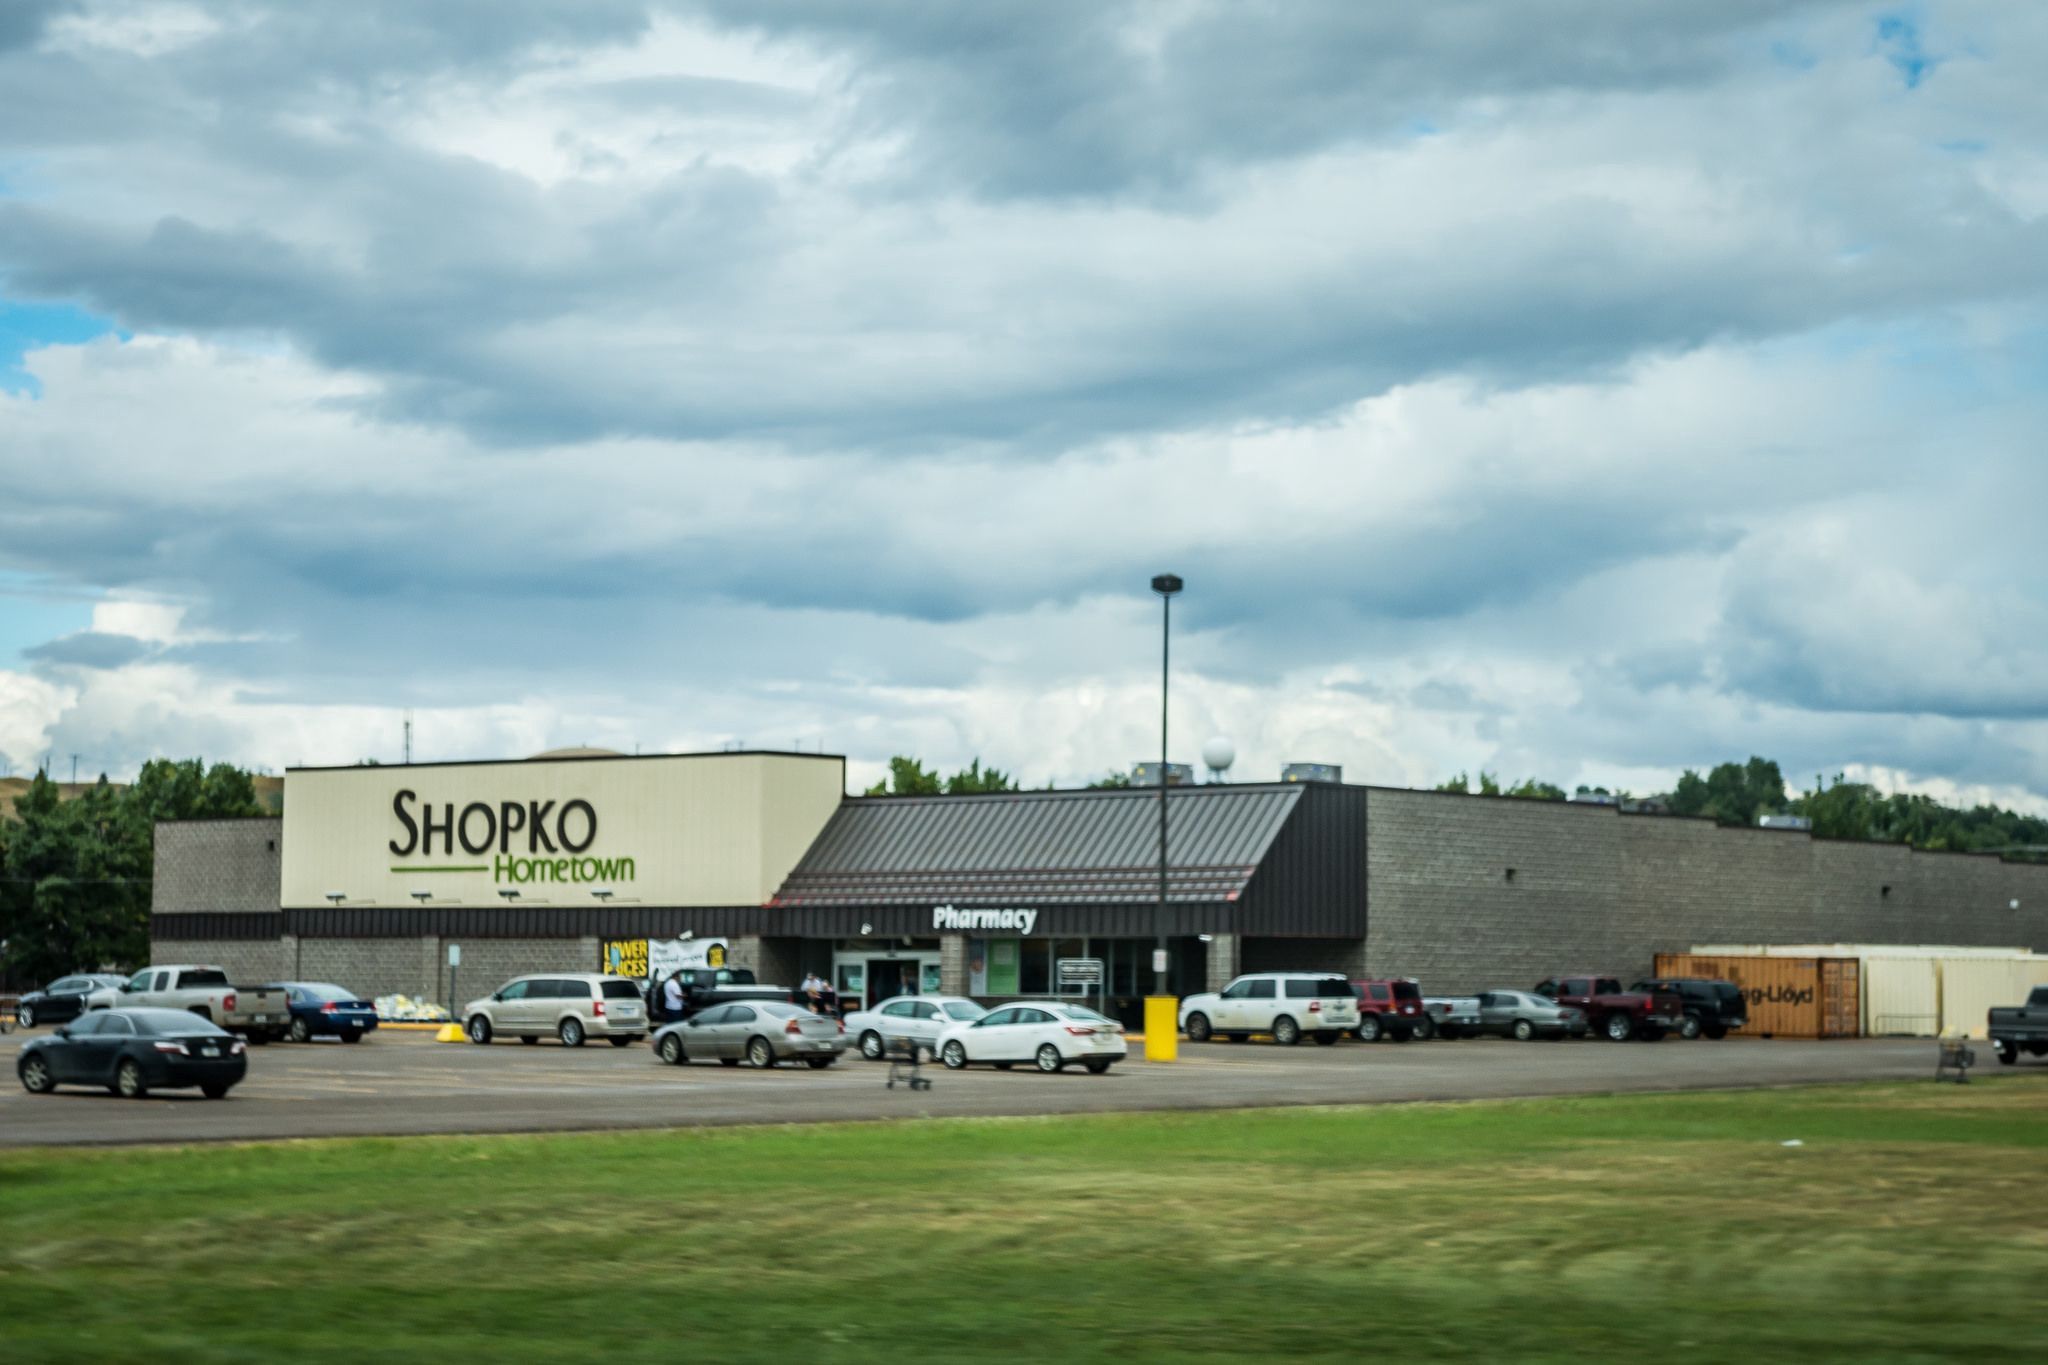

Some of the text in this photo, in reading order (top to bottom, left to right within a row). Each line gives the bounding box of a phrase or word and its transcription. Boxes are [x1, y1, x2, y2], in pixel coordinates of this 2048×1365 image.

[389, 789, 597, 857] SHOPKO
[495, 854, 635, 884] Hometown
[933, 904, 1037, 935] Pharmacy
